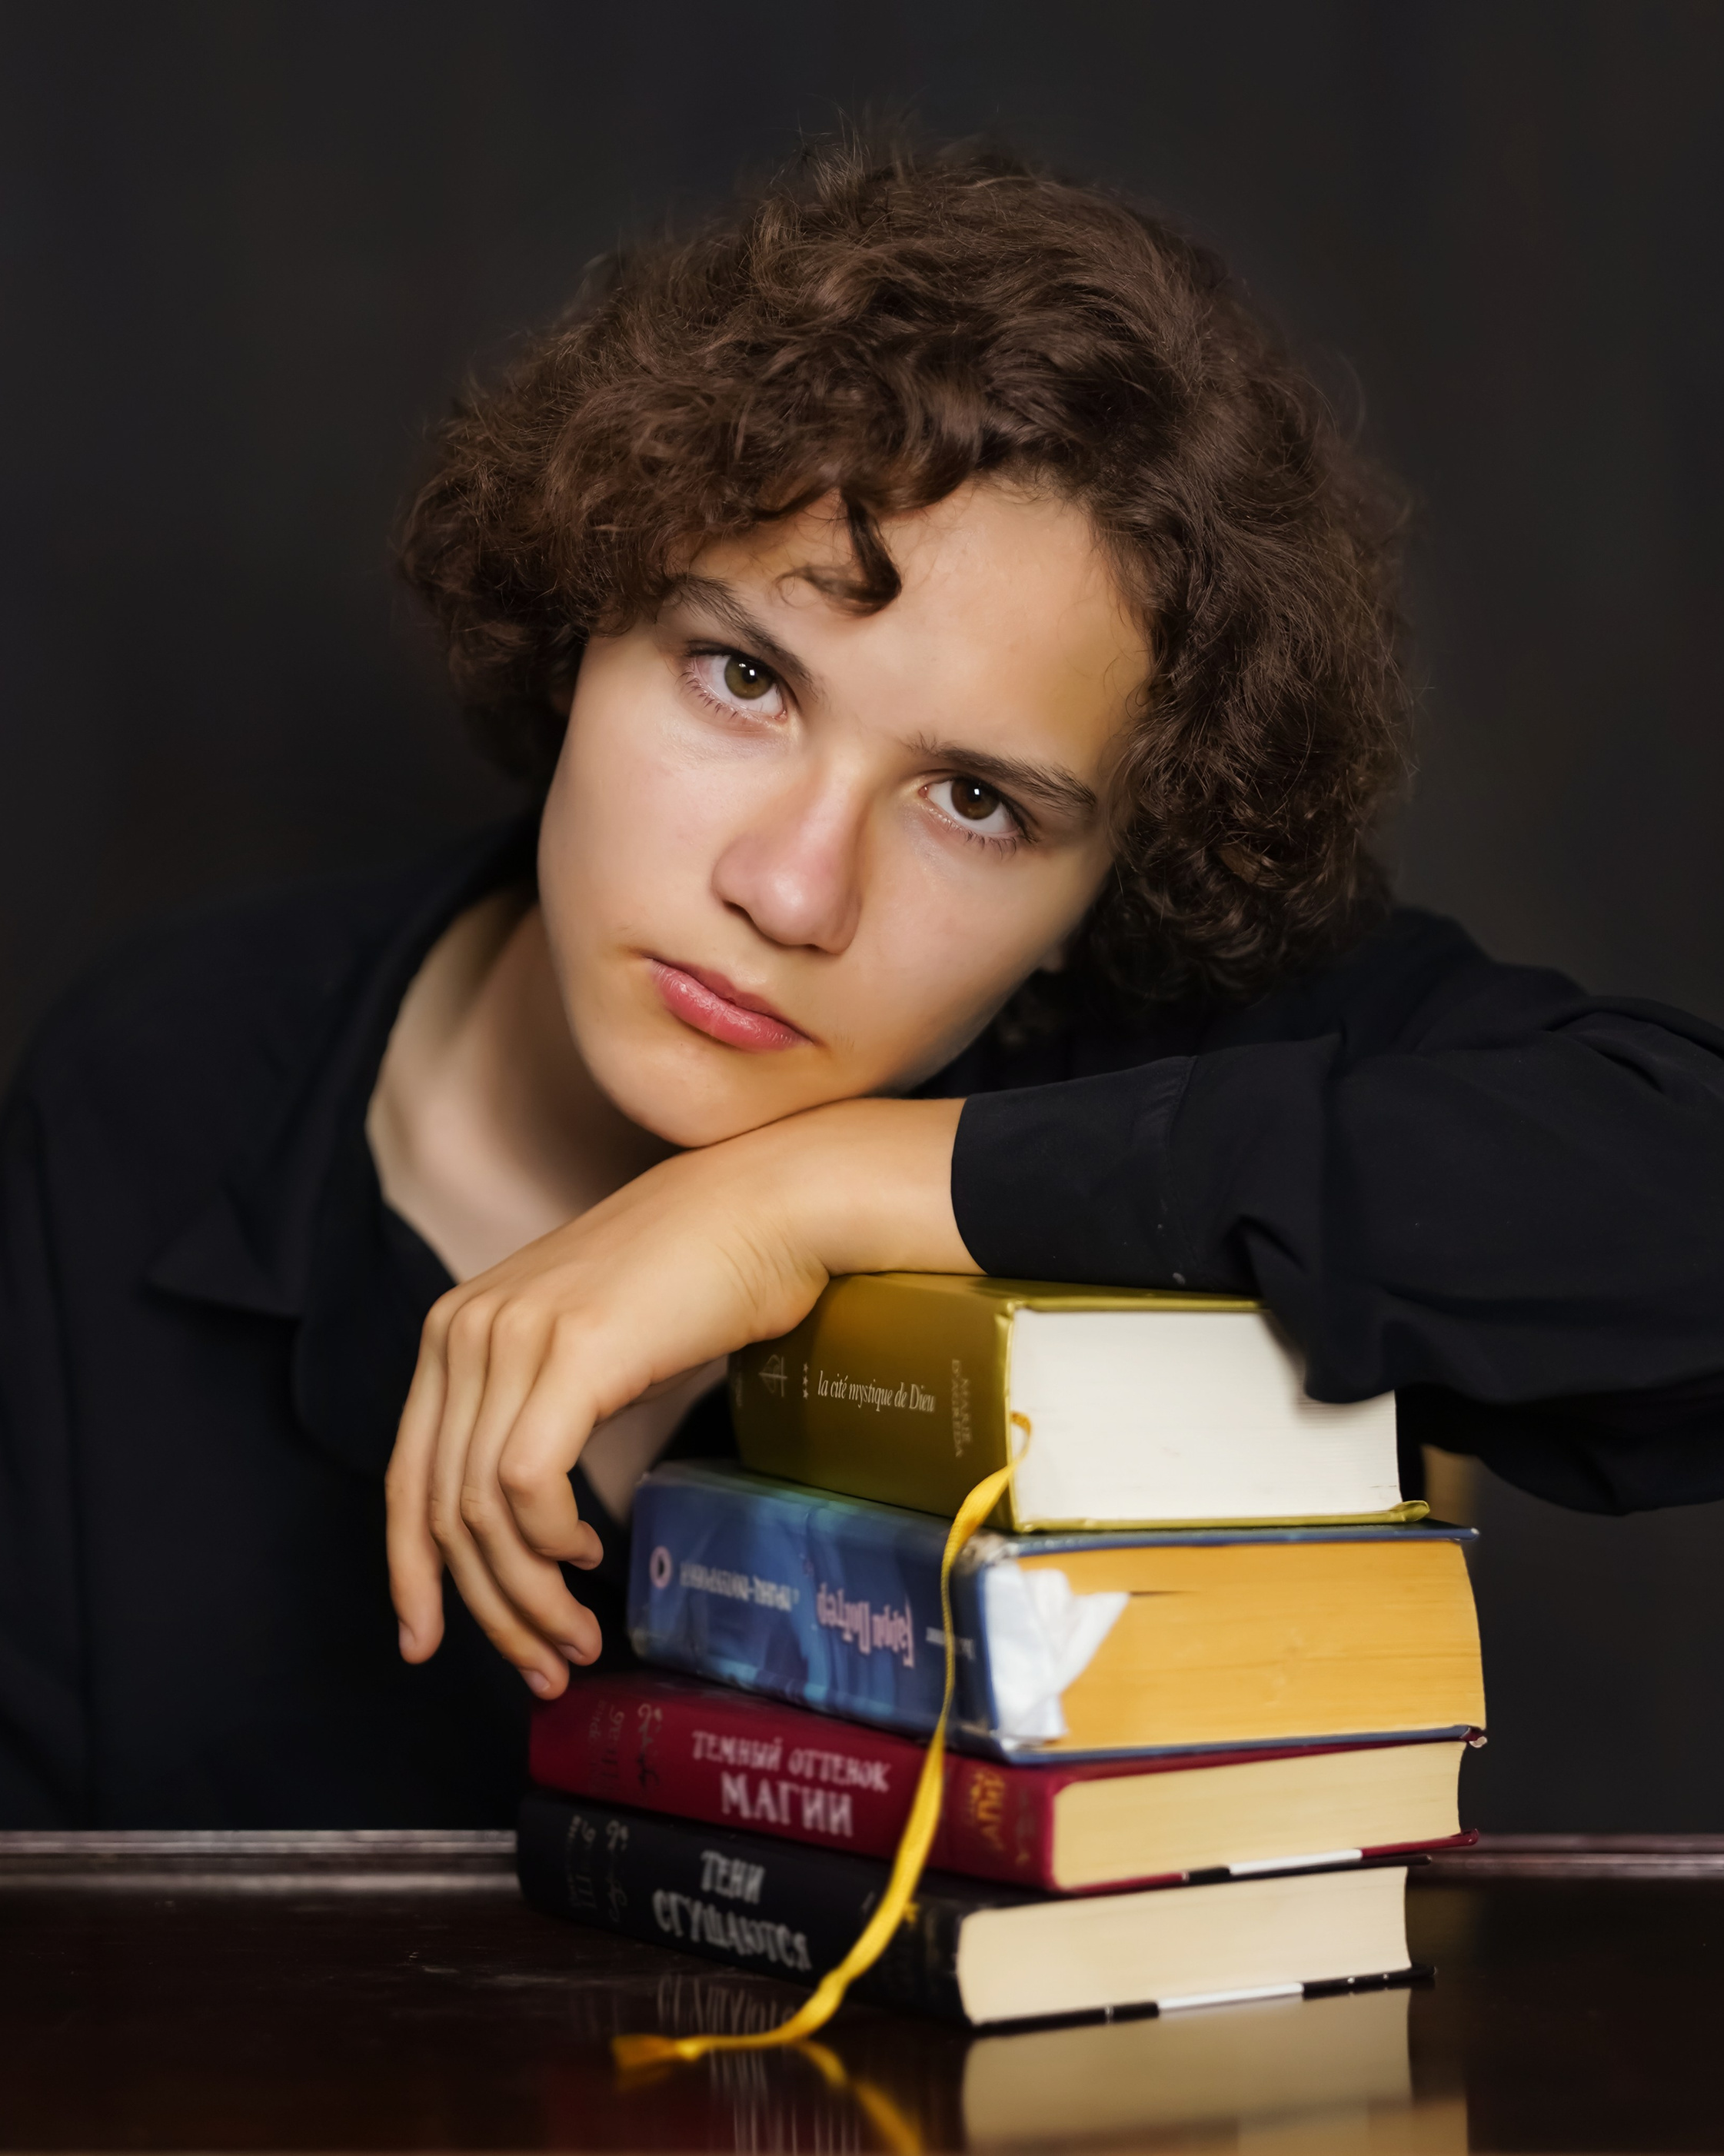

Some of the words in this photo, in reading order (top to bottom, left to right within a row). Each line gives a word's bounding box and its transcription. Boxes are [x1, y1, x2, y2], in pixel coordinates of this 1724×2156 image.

[817, 1370, 828, 1396] la
[830, 1372, 847, 1399] cité
[849, 1378, 892, 1412] mystique
[894, 1382, 908, 1409] de
[910, 1383, 935, 1412] Dieu
[691, 1731, 783, 1772] ТЕМНЫЙ
[787, 1748, 891, 1793] ОТТЕНОК
[720, 1772, 854, 1838] МАГИИ
[701, 1850, 765, 1903] ТЕНИ
[653, 1890, 813, 1972] СГУЩАЮТСЯ
